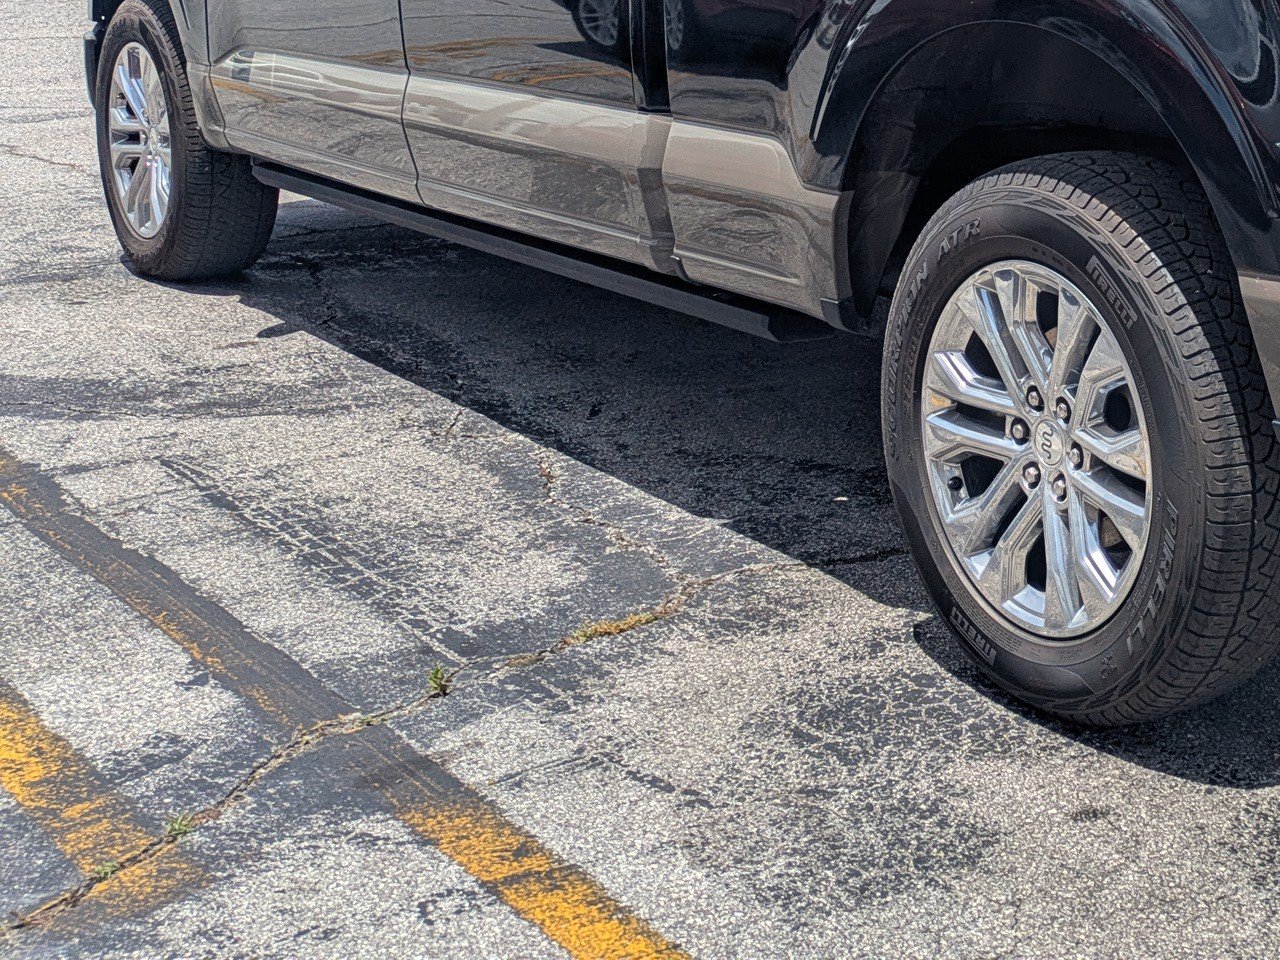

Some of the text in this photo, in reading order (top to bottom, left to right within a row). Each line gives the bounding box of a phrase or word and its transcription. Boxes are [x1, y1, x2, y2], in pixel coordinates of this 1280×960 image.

[937, 218, 981, 263] ATR
[1085, 254, 1138, 330] PIRELLI
[1126, 496, 1179, 656] PIRELLI
